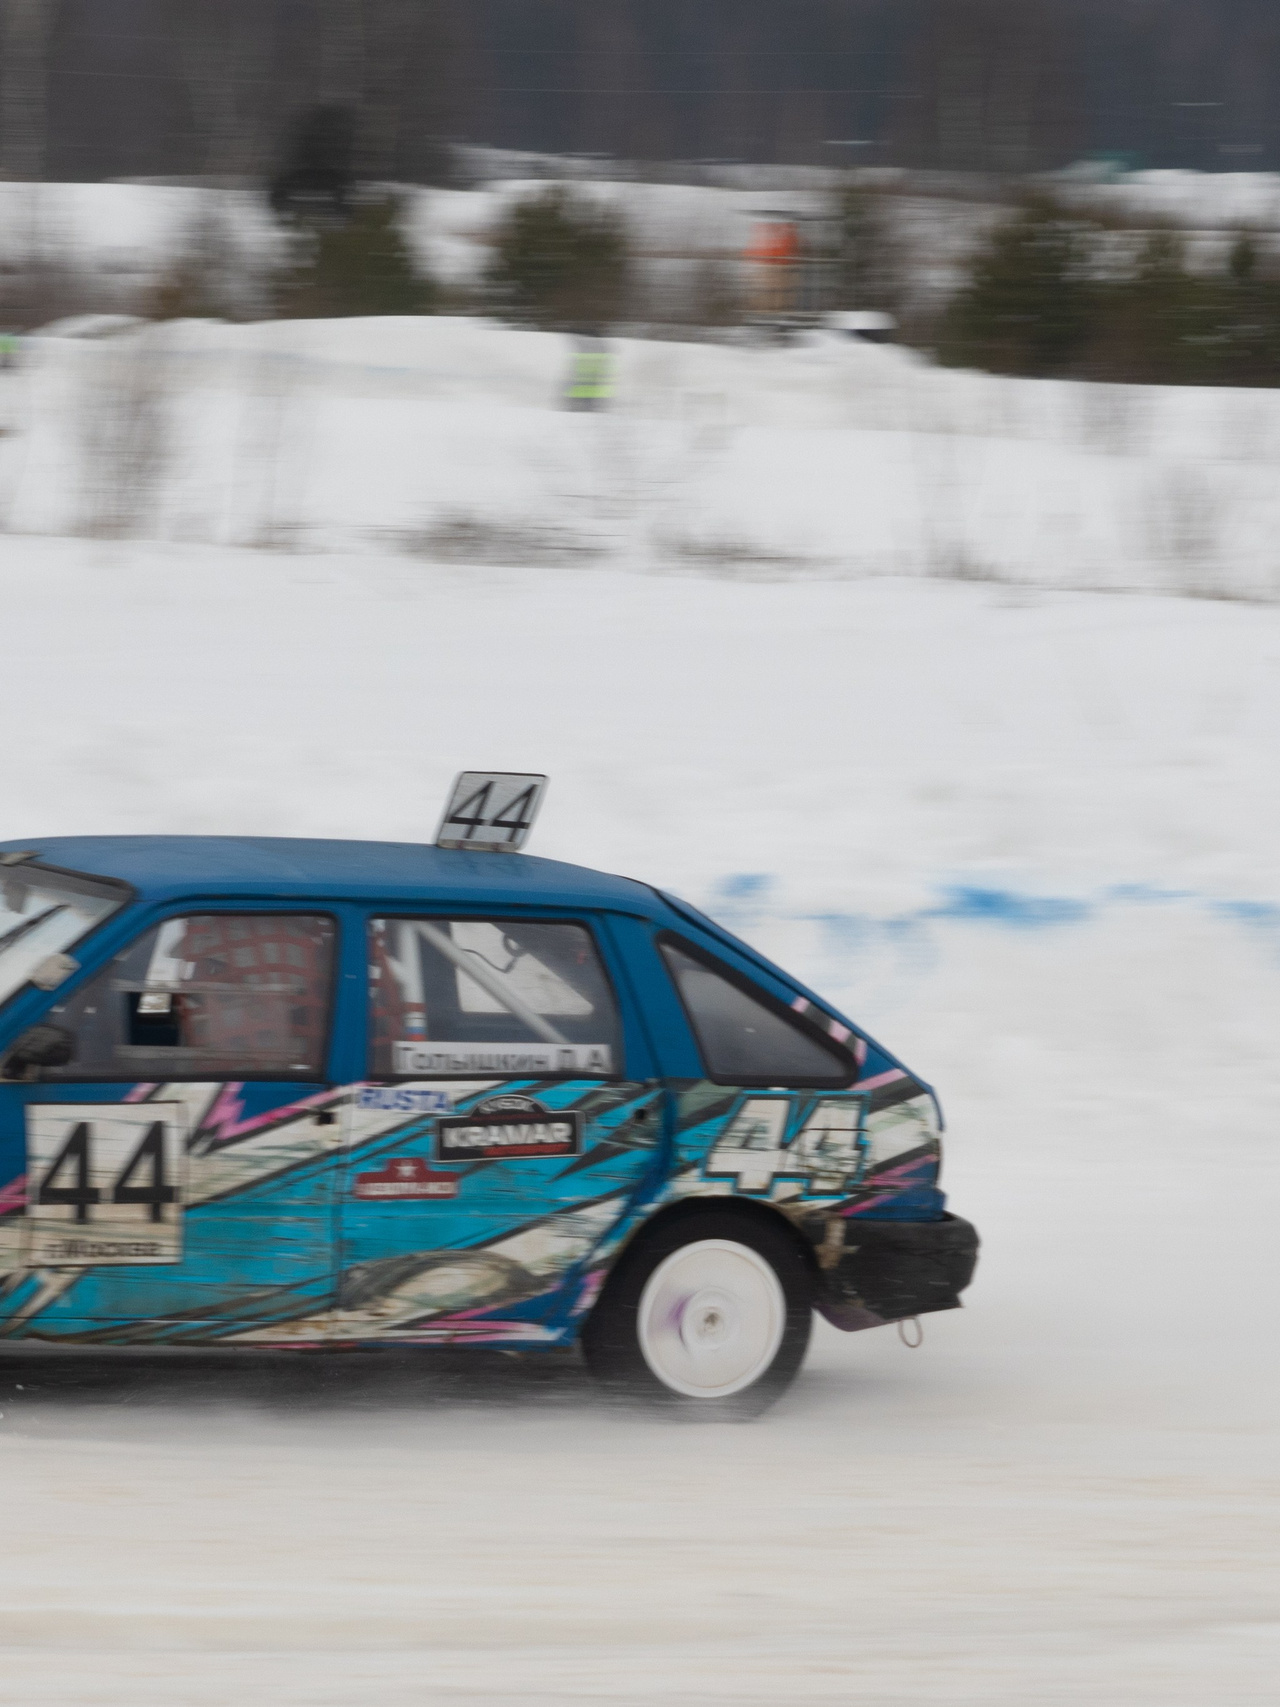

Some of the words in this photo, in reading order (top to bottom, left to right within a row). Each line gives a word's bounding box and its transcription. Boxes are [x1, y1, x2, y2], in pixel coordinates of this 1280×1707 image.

[446, 780, 538, 842] 44
[397, 1046, 550, 1072] Голышкин
[357, 1088, 450, 1112] RUSTA
[441, 1121, 573, 1149] KRAMAR
[704, 1094, 866, 1194] 44
[38, 1120, 176, 1224] 44
